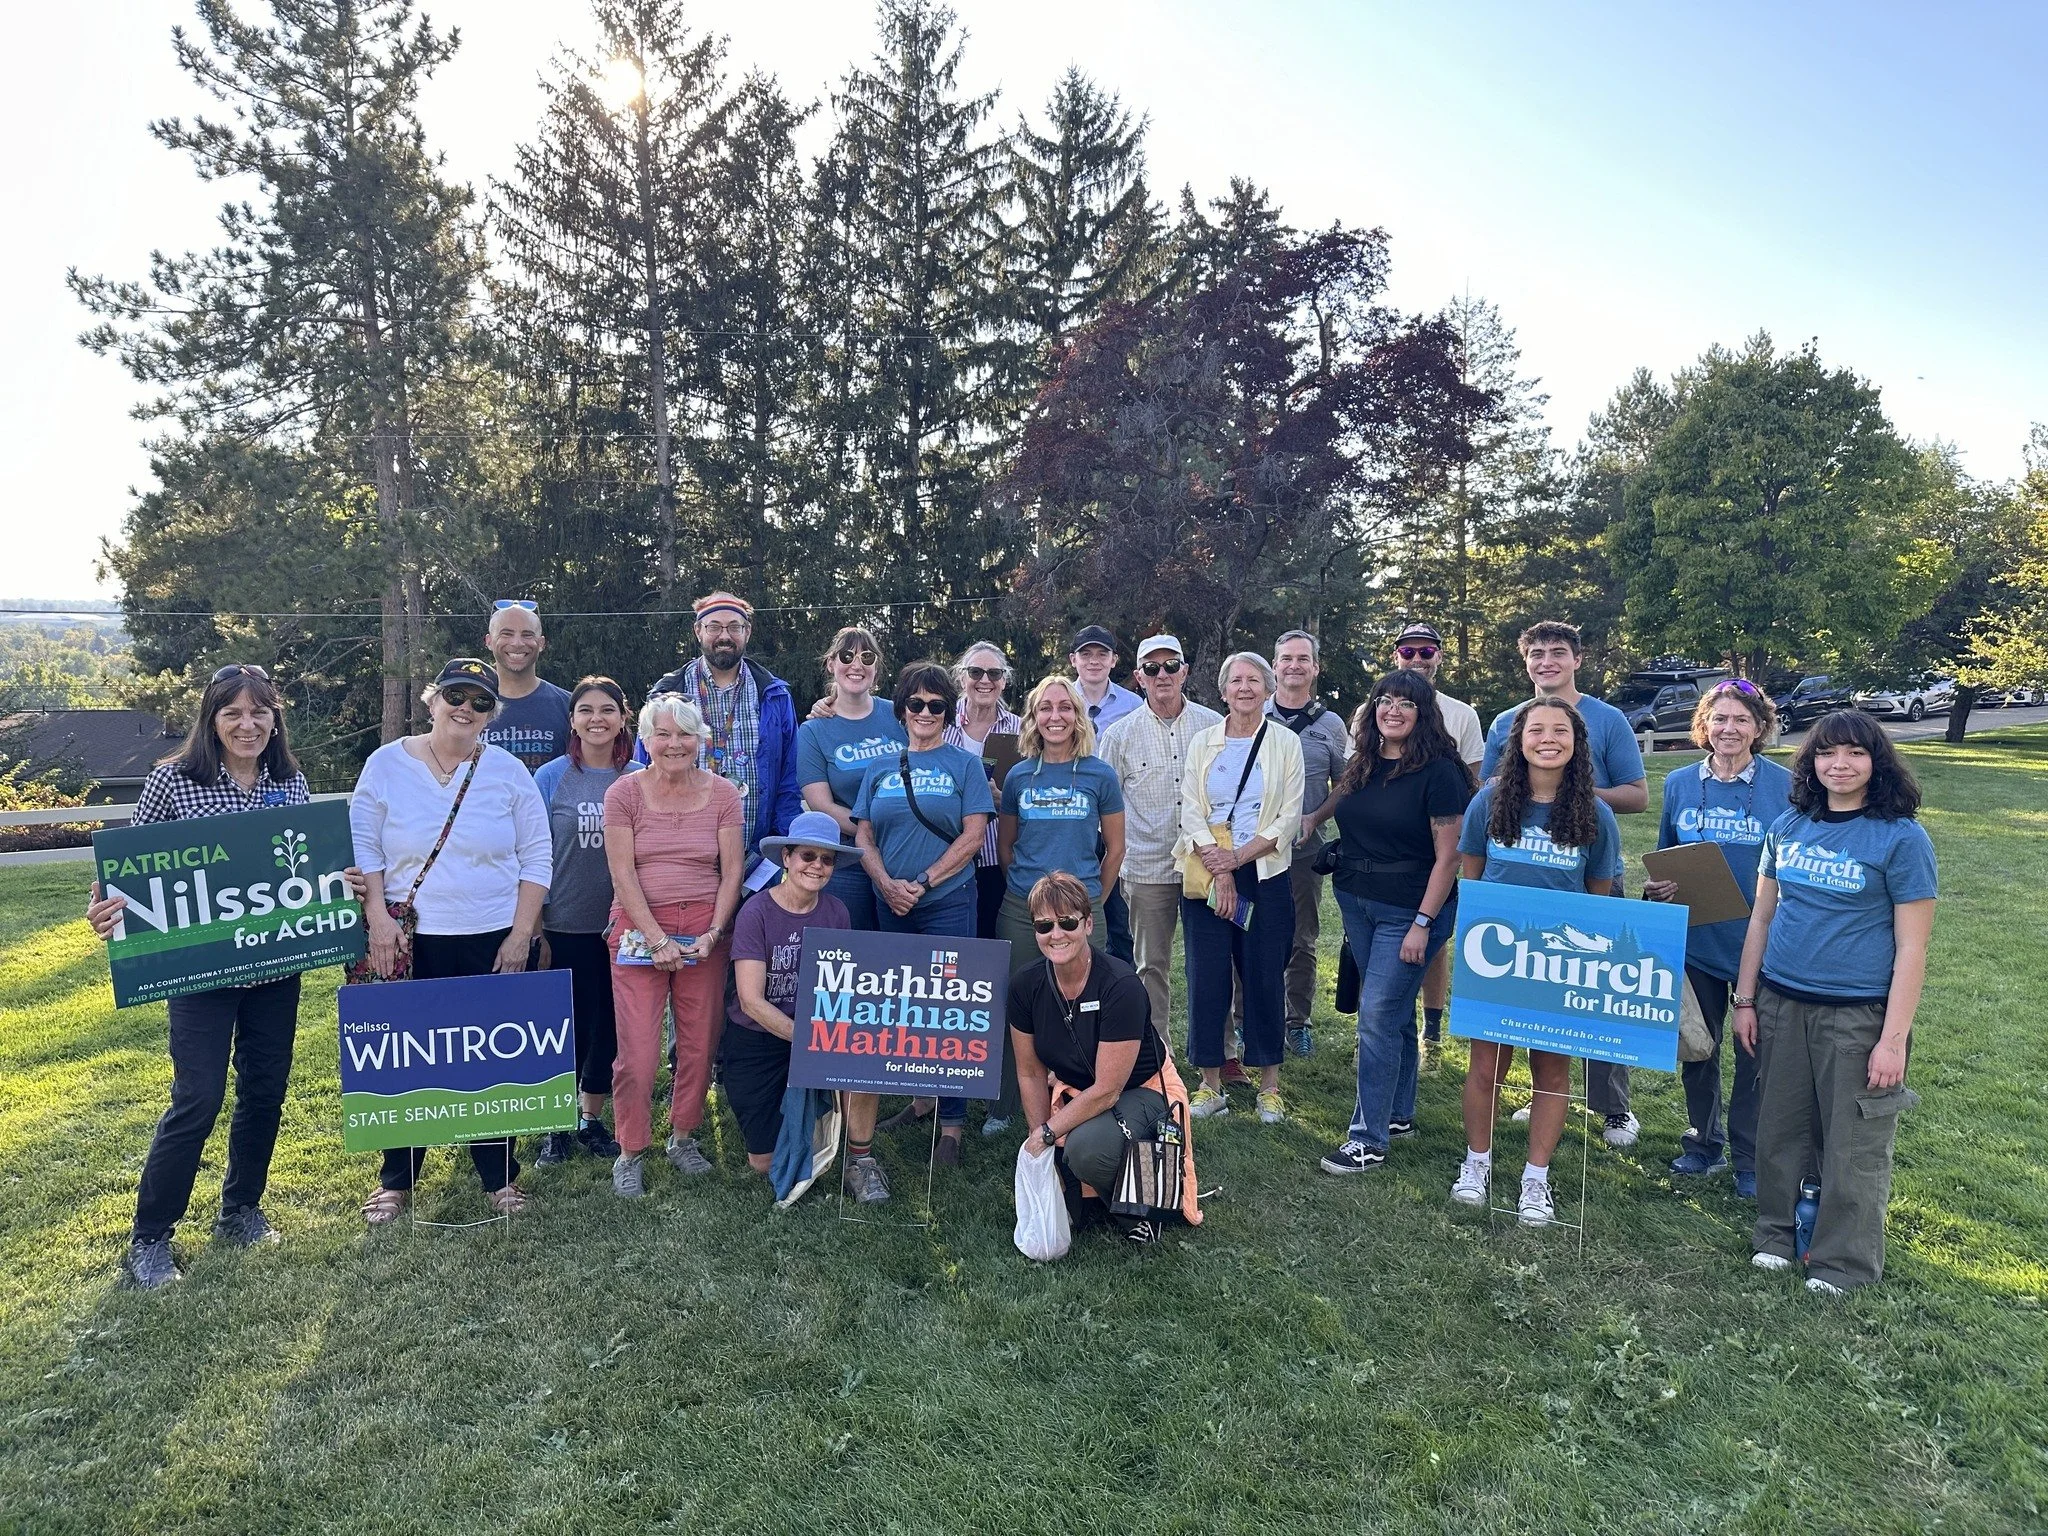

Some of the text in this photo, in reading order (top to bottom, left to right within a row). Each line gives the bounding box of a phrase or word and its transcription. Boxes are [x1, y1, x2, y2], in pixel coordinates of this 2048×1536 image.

[477, 726, 554, 742] Mathias
[502, 740, 553, 753] thias
[836, 740, 903, 762] Church
[927, 786, 950, 794] Idaho
[578, 802, 604, 815] CA
[1065, 808, 1087, 816] Idaho
[578, 816, 604, 831] HIK
[1677, 810, 1760, 833] Church
[578, 833, 603, 848] VO
[103, 844, 230, 880] PATRICIA
[1532, 853, 1577, 867] for Idaho
[1776, 842, 1860, 879] Church
[1809, 873, 1859, 889] for Idaho
[106, 869, 354, 941] Nilsson
[234, 909, 357, 949] for ACHD
[788, 932, 801, 942] the
[772, 945, 801, 970] HOT
[818, 949, 851, 961] vote
[1464, 923, 1675, 1001] Church
[128, 995, 147, 1003] PAID
[149, 991, 166, 999] FOR
[180, 981, 214, 993] NILSSON
[216, 977, 232, 985] FOR
[234, 972, 256, 982] ACHD
[265, 968, 278, 976] JIM
[280, 961, 313, 972] HANSEN,
[314, 953, 355, 965] TREASURER
[157, 977, 186, 987] COUNTY
[189, 970, 221, 980] HIGHWAY
[224, 962, 253, 974] DISTRICT
[312, 947, 338, 957] DISTRICT
[814, 960, 992, 1003] Mathias
[811, 991, 990, 1032] Mathias
[1564, 990, 1675, 1023] for Idaho
[344, 1022, 390, 1034] Melissa
[345, 1018, 570, 1072] WINTROW
[808, 1020, 988, 1062] Mathias
[886, 1061, 902, 1072] for
[947, 1066, 984, 1078] people
[349, 1094, 572, 1128] STATE SENATE DISTRICT 19
